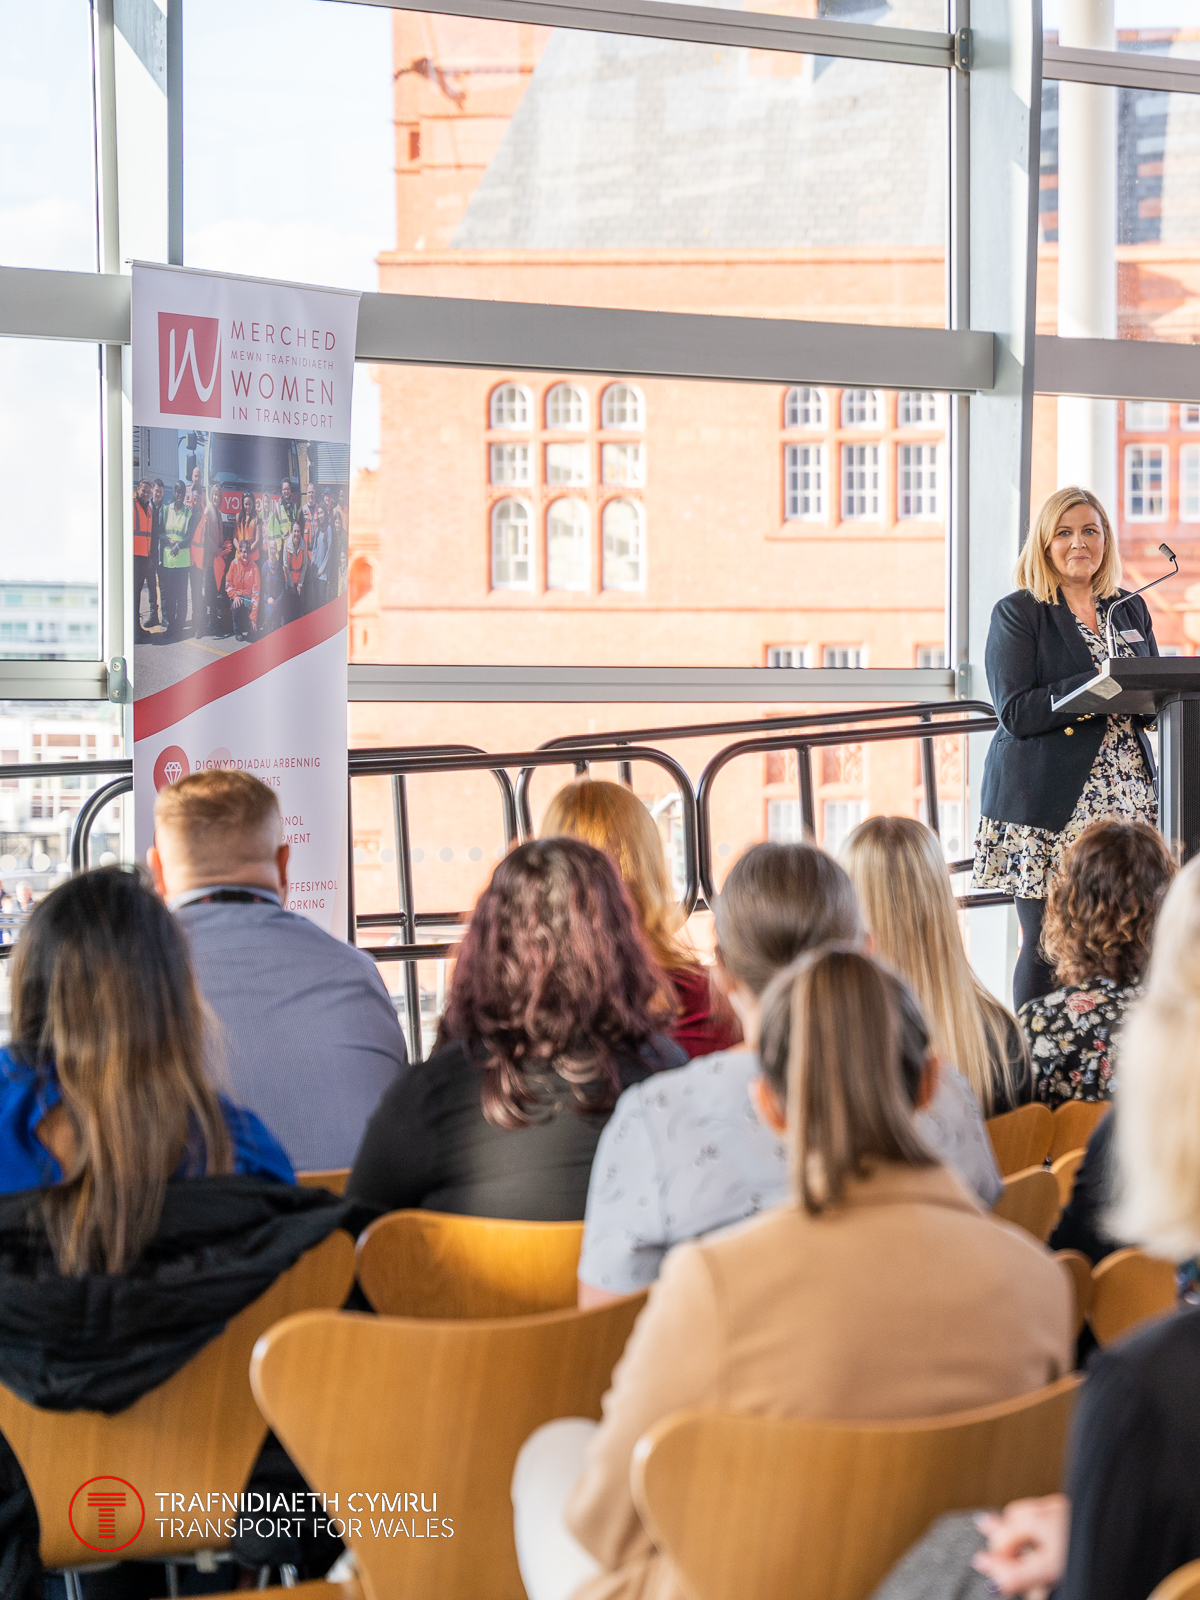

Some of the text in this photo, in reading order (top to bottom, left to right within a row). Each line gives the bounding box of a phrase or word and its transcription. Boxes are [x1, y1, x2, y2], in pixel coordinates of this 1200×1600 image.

[231, 320, 336, 350] MERCHED
[231, 350, 334, 371] MEWN TRAFNIDIAETH
[231, 370, 333, 406] WOMEN
[232, 407, 333, 429] IN TRANSPORT
[196, 758, 321, 770] DIGWYDDIADAU ARBENNIG
[290, 880, 337, 892] FFESIYNOL
